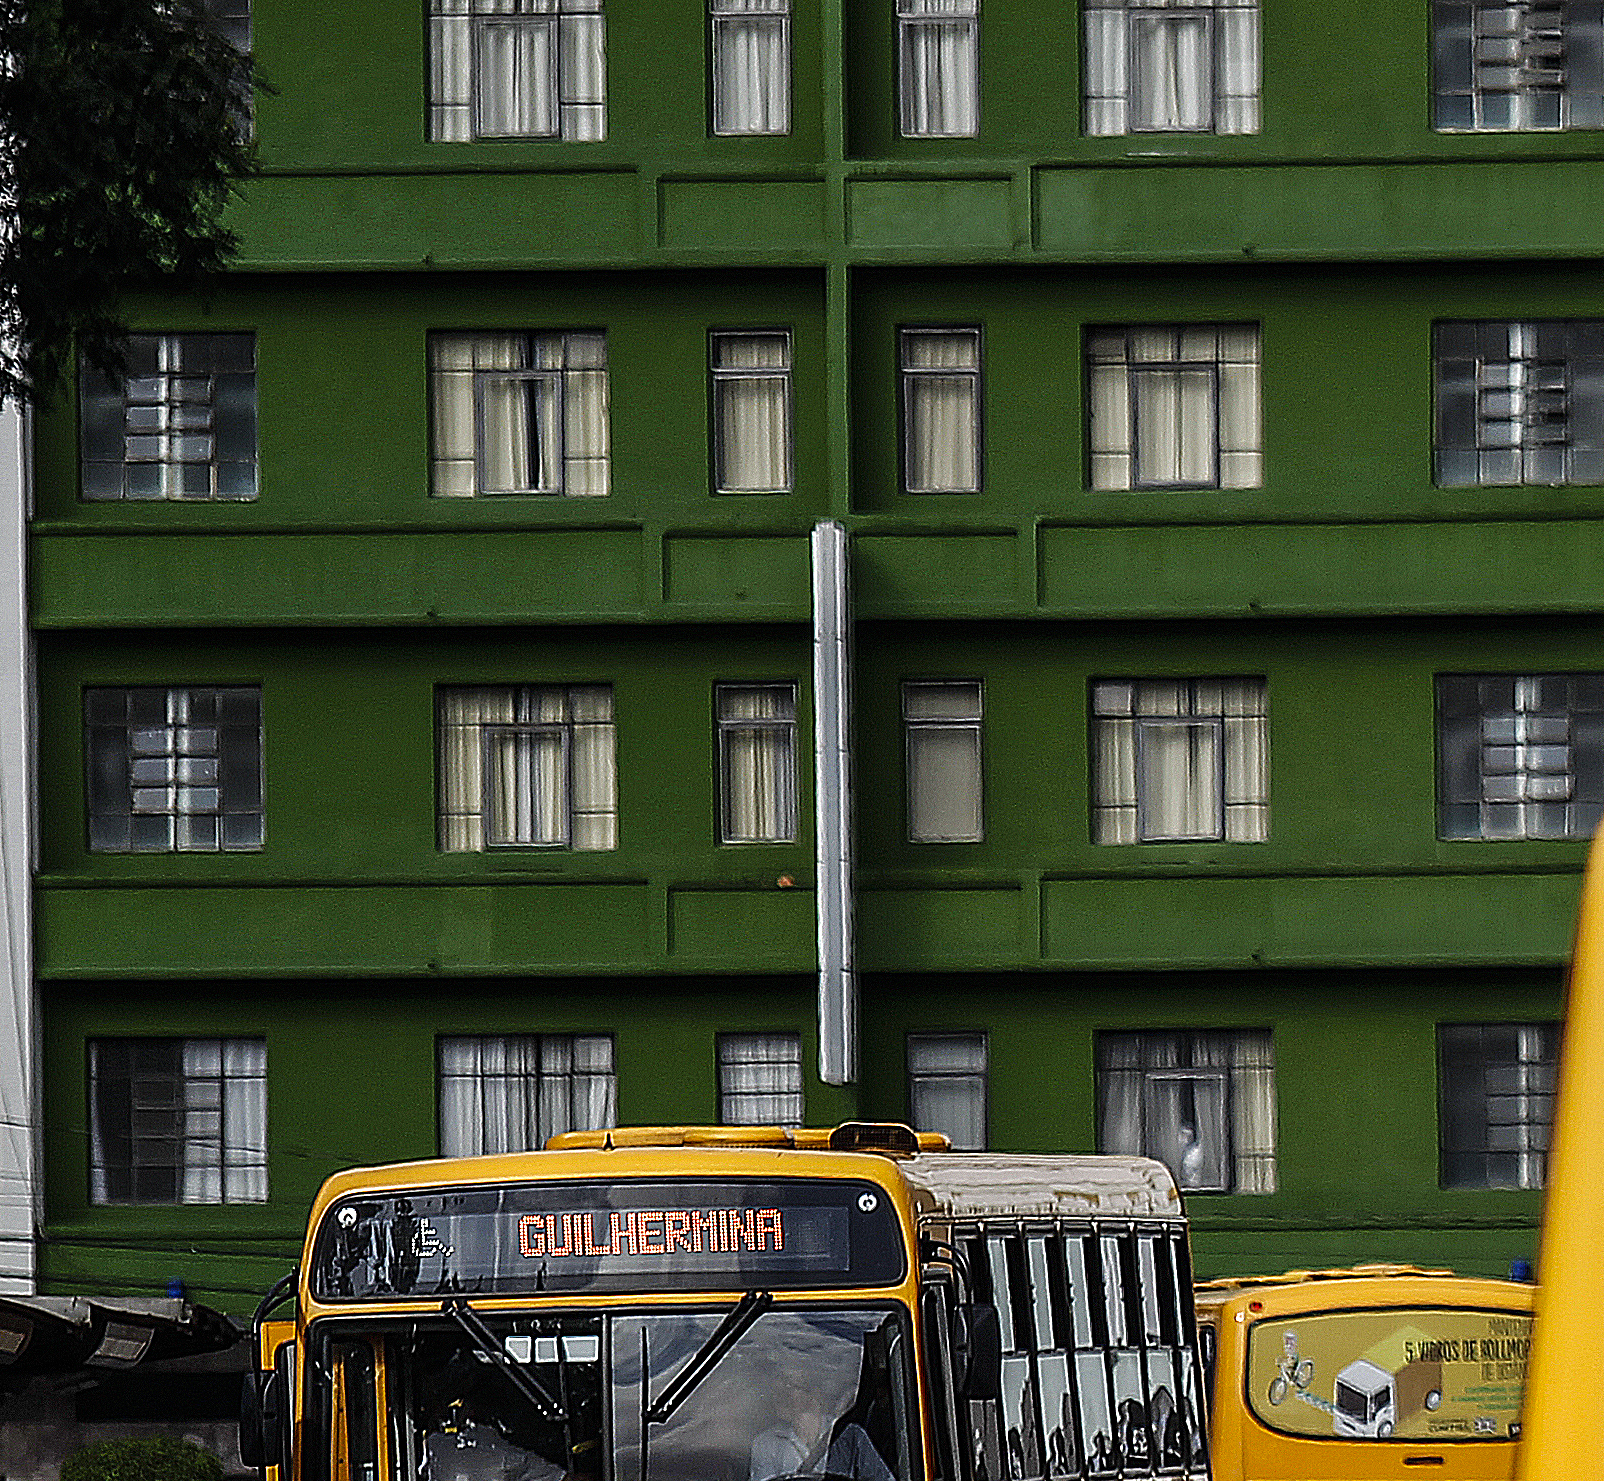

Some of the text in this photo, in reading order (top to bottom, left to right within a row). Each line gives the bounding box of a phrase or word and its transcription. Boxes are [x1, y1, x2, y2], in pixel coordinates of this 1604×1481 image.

[519, 1208, 784, 1257] GUILHERMINA
[1405, 1340, 1414, 1362] 5
[1462, 1340, 1477, 1362] DE
